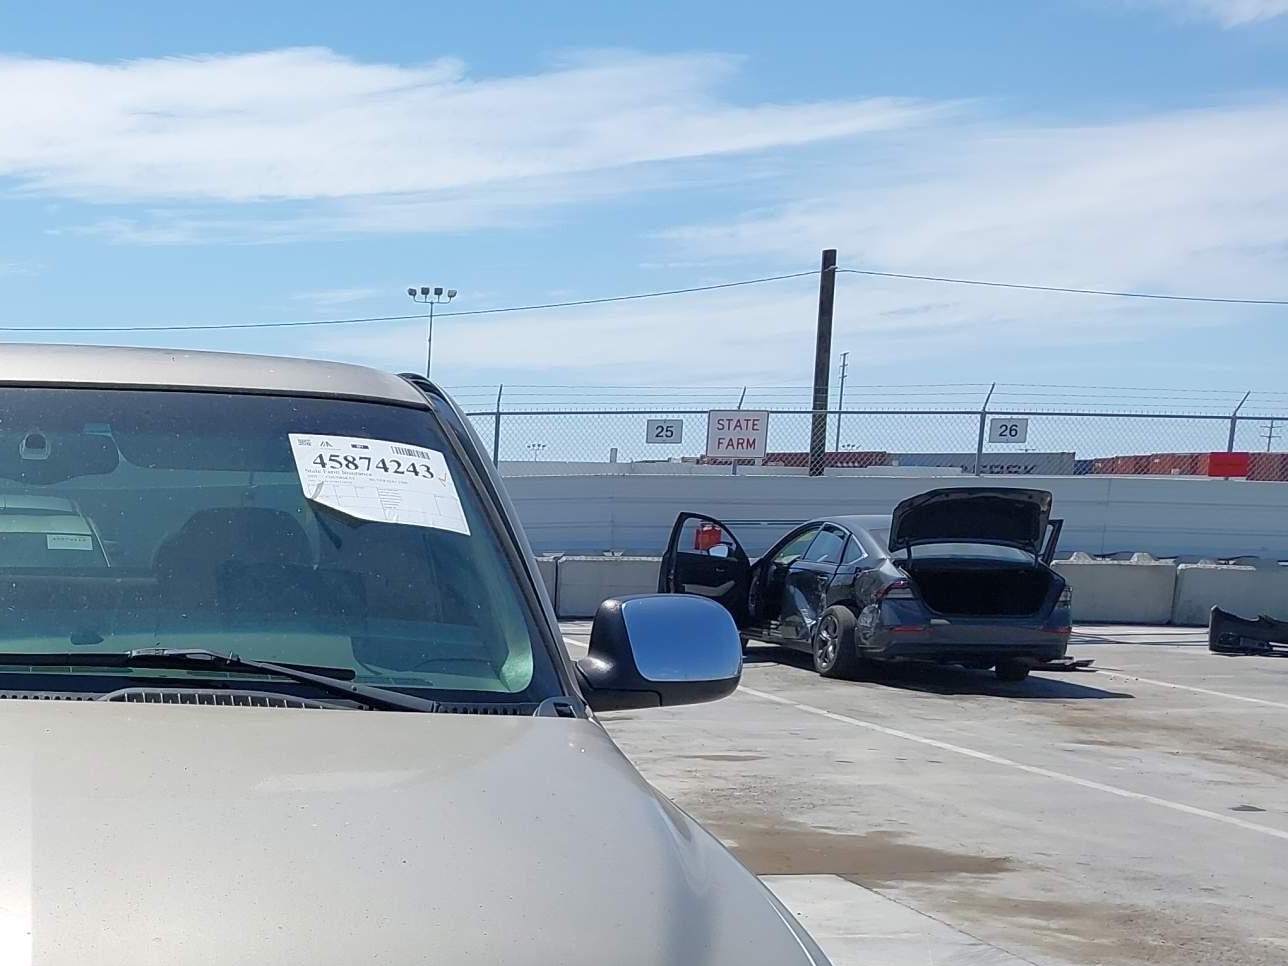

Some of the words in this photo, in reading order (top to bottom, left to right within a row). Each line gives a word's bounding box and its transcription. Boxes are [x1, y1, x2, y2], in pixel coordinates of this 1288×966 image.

[716, 418, 761, 431] STATE
[998, 424, 1018, 437] 26
[655, 425, 674, 438] 25
[716, 437, 757, 450] FARM
[312, 453, 435, 479] 45874243
